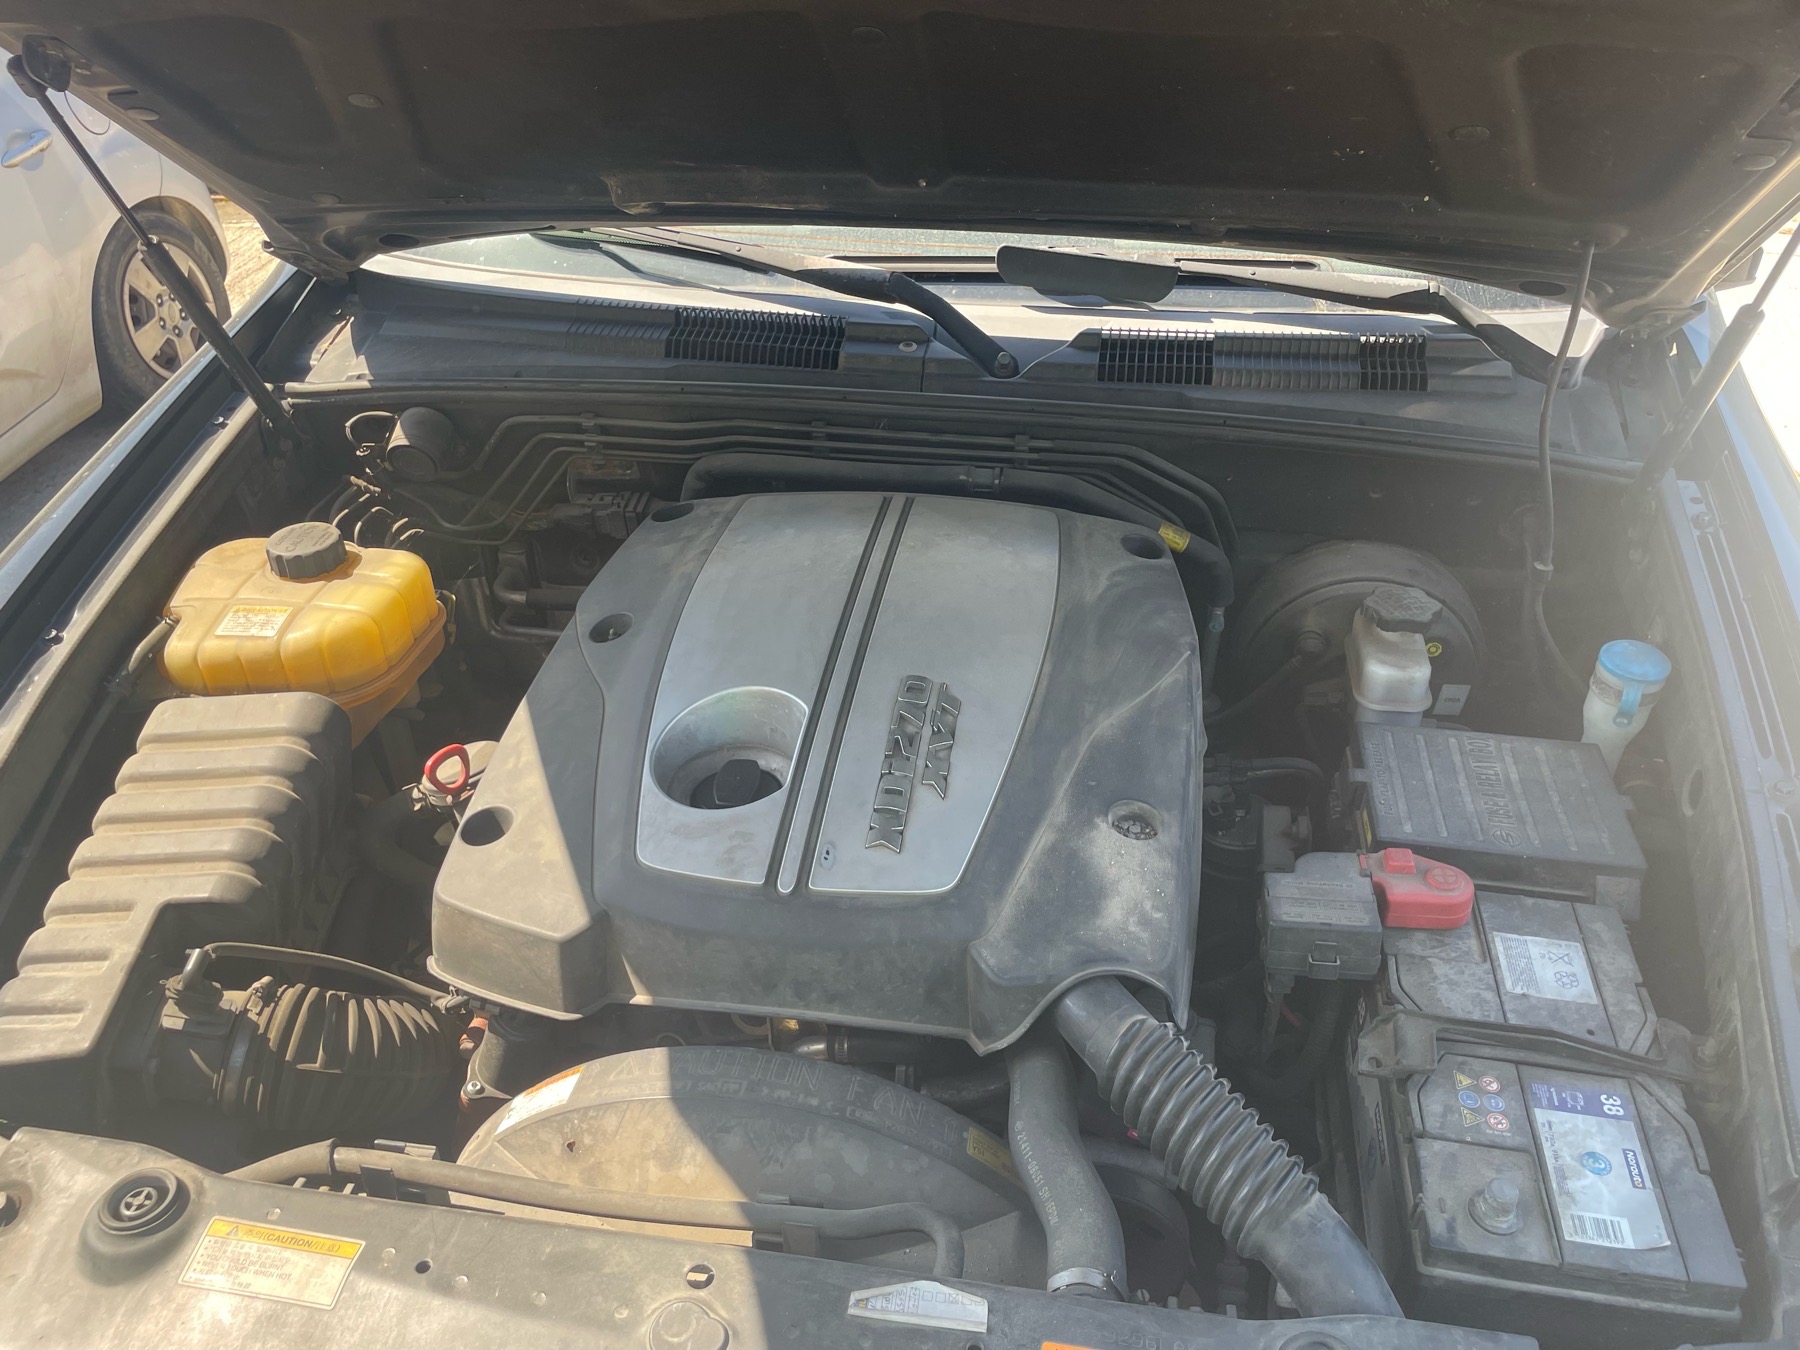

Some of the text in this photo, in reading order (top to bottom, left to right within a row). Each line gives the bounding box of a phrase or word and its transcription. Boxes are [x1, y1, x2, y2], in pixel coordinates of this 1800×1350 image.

[1371, 742, 1386, 766] RELEASE
[1463, 735, 1495, 756] BOX
[1376, 769, 1386, 781] TO
[1470, 760, 1504, 790] RELAY
[1483, 800, 1516, 827] FUSE
[647, 1043, 825, 1092] CAUTION
[846, 1074, 926, 1126] FAN
[1599, 1093, 1625, 1117] 38
[1625, 1149, 1643, 1189] Norauto
[252, 1268, 276, 1279] WHEN
